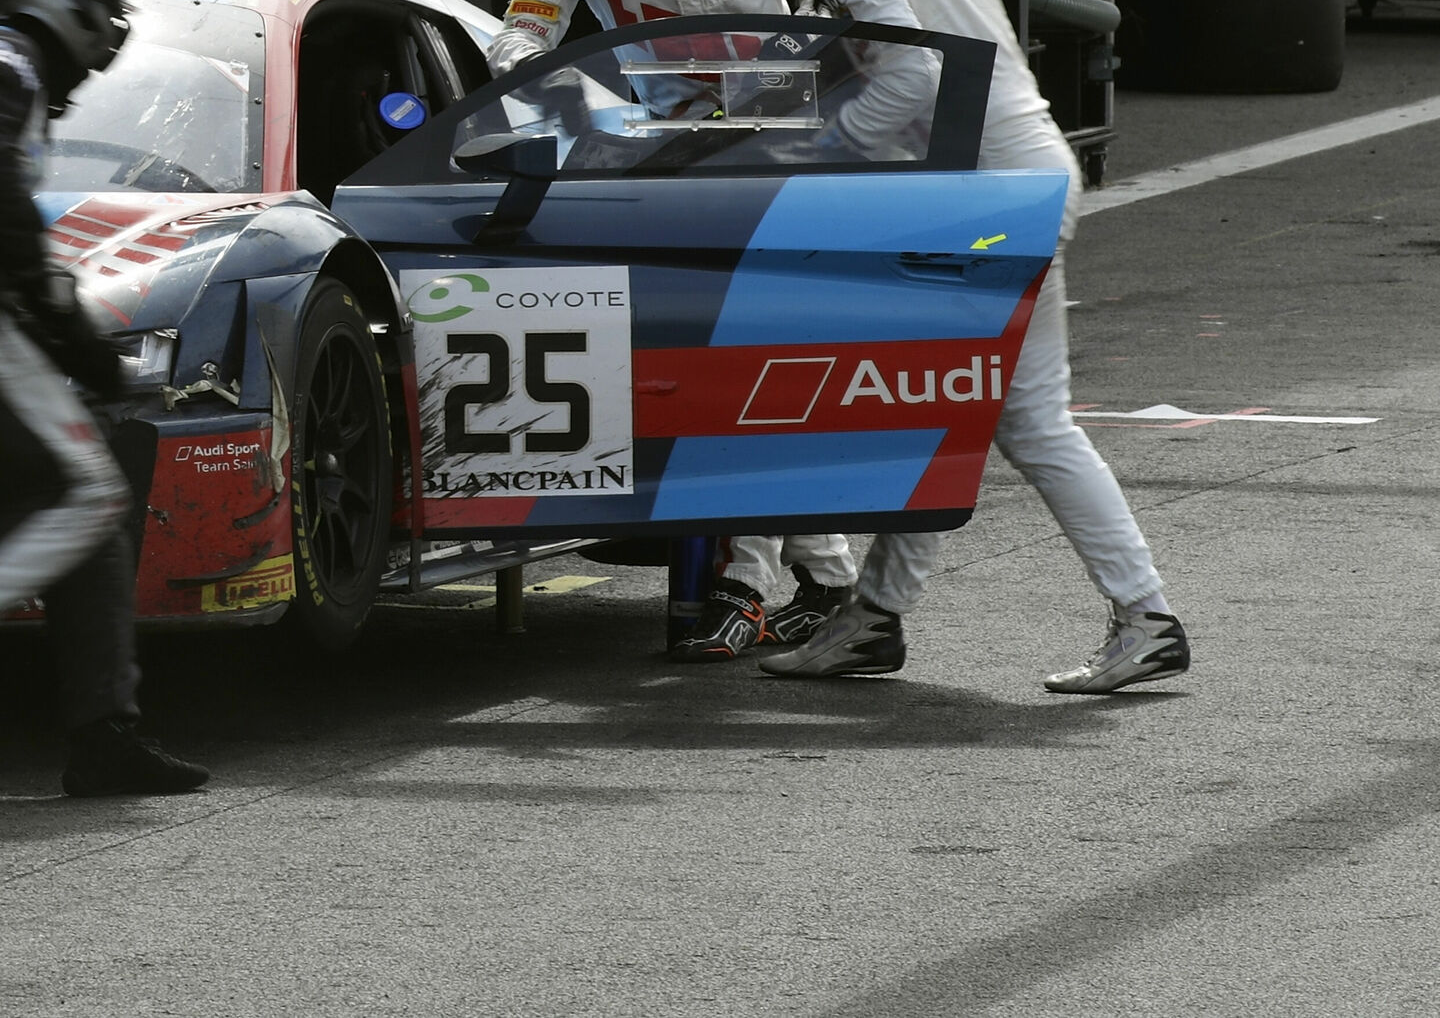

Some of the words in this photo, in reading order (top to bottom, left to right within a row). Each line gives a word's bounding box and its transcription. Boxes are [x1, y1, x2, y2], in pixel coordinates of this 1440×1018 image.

[511, 1, 555, 18] PIRELLI
[495, 291, 625, 309] COYOTE
[839, 355, 1002, 406] Audi
[444, 332, 591, 454] 25
[193, 444, 225, 458] Audi
[226, 442, 261, 457] Sport
[194, 461, 230, 473] Team
[421, 465, 628, 493] BLANCPAIN
